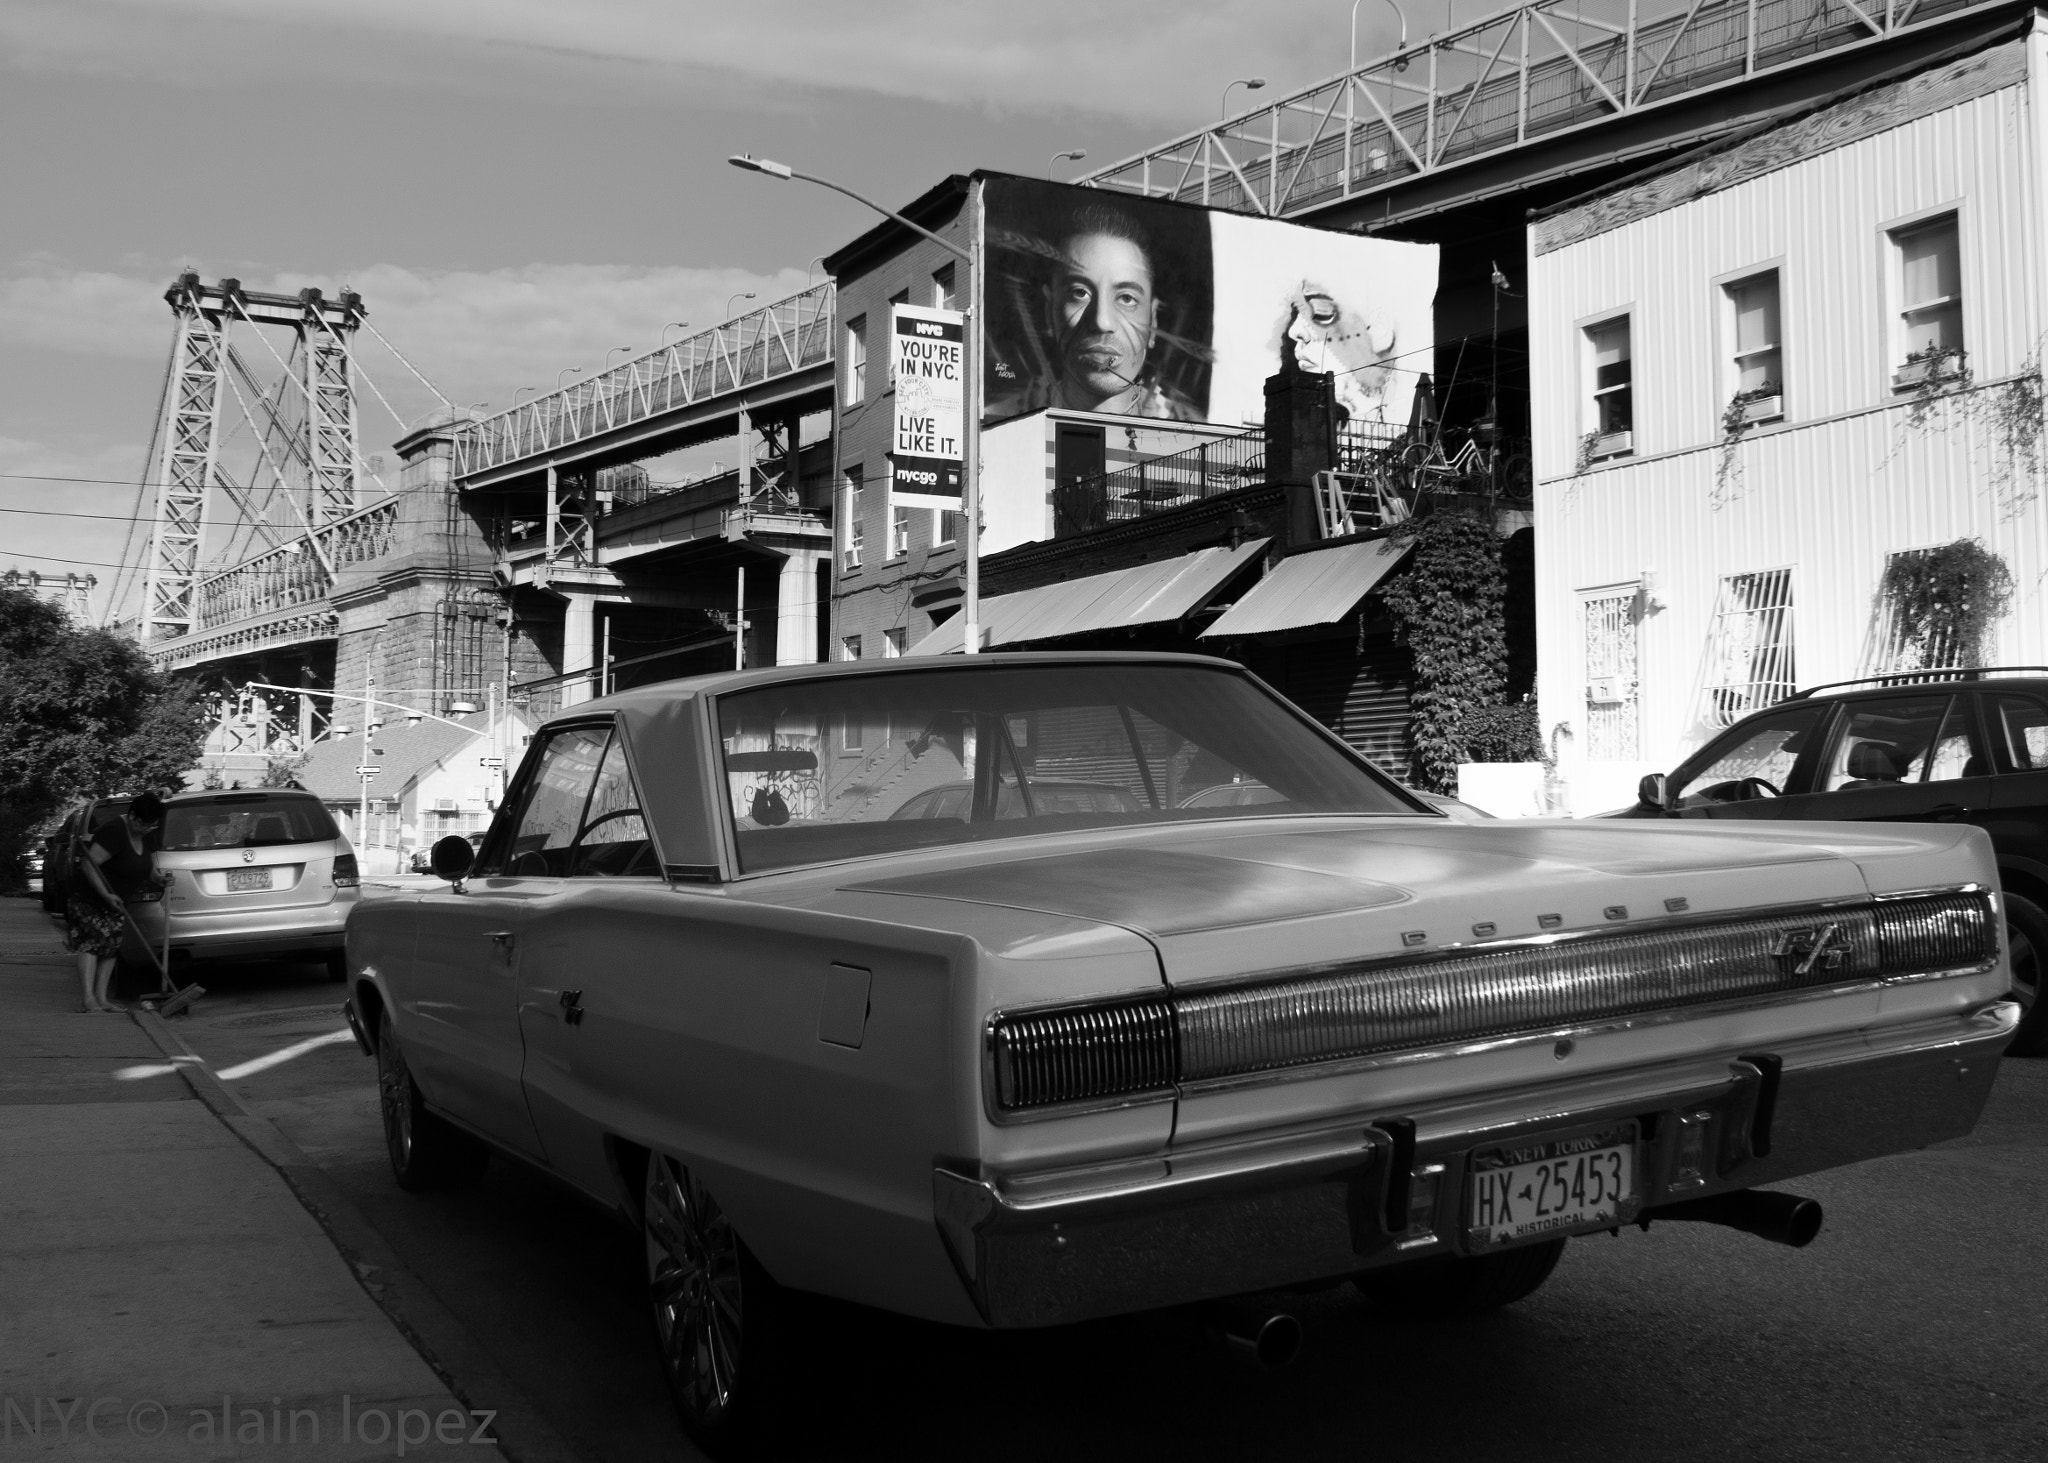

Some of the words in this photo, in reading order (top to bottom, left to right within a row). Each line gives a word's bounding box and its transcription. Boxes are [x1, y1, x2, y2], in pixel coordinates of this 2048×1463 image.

[916, 323, 943, 336] NYC
[901, 340, 960, 364] YOU'RE
[901, 358, 917, 376] IN
[922, 362, 959, 381] NYC.
[899, 415, 935, 434] LIVE
[899, 433, 935, 453] LIKE
[940, 437, 958, 455] IT.
[896, 469, 938, 485] nycgo
[1401, 896, 1690, 946] DODGE
[1774, 922, 1853, 974] R/T
[1479, 1171, 1513, 1227] HX
[1535, 1152, 1622, 1217] 25453
[1516, 1212, 1586, 1235] HISTORICAL
